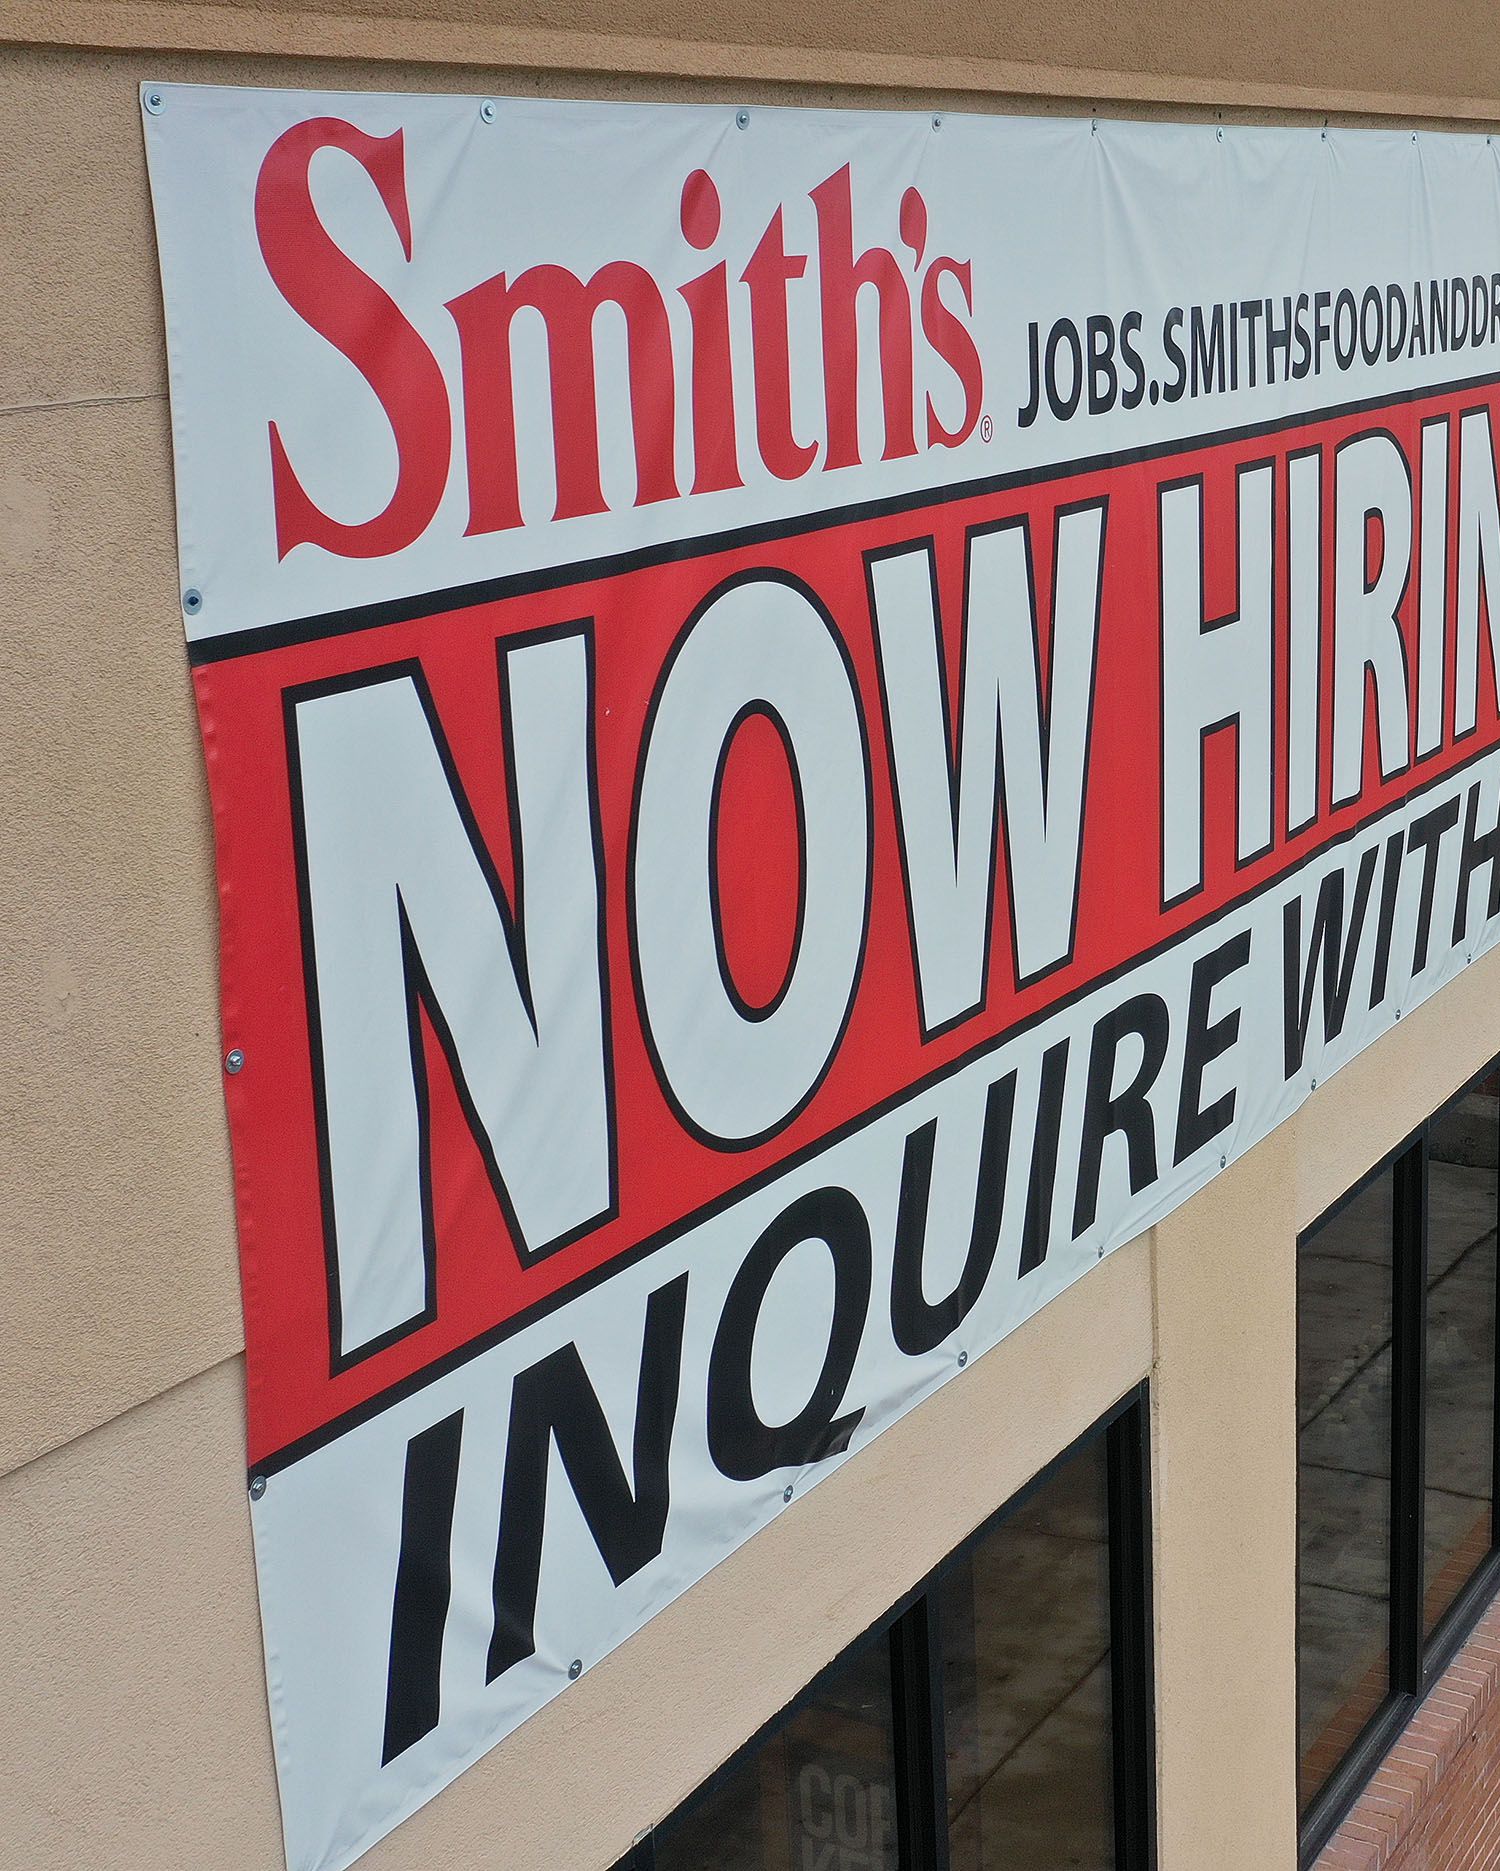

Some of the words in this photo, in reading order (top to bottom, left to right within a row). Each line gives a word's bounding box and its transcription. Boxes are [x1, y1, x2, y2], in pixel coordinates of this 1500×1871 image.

[253, 116, 984, 563] Smith's
[282, 496, 1109, 1378] NOW
[380, 928, 1252, 1769] INQUIRE
